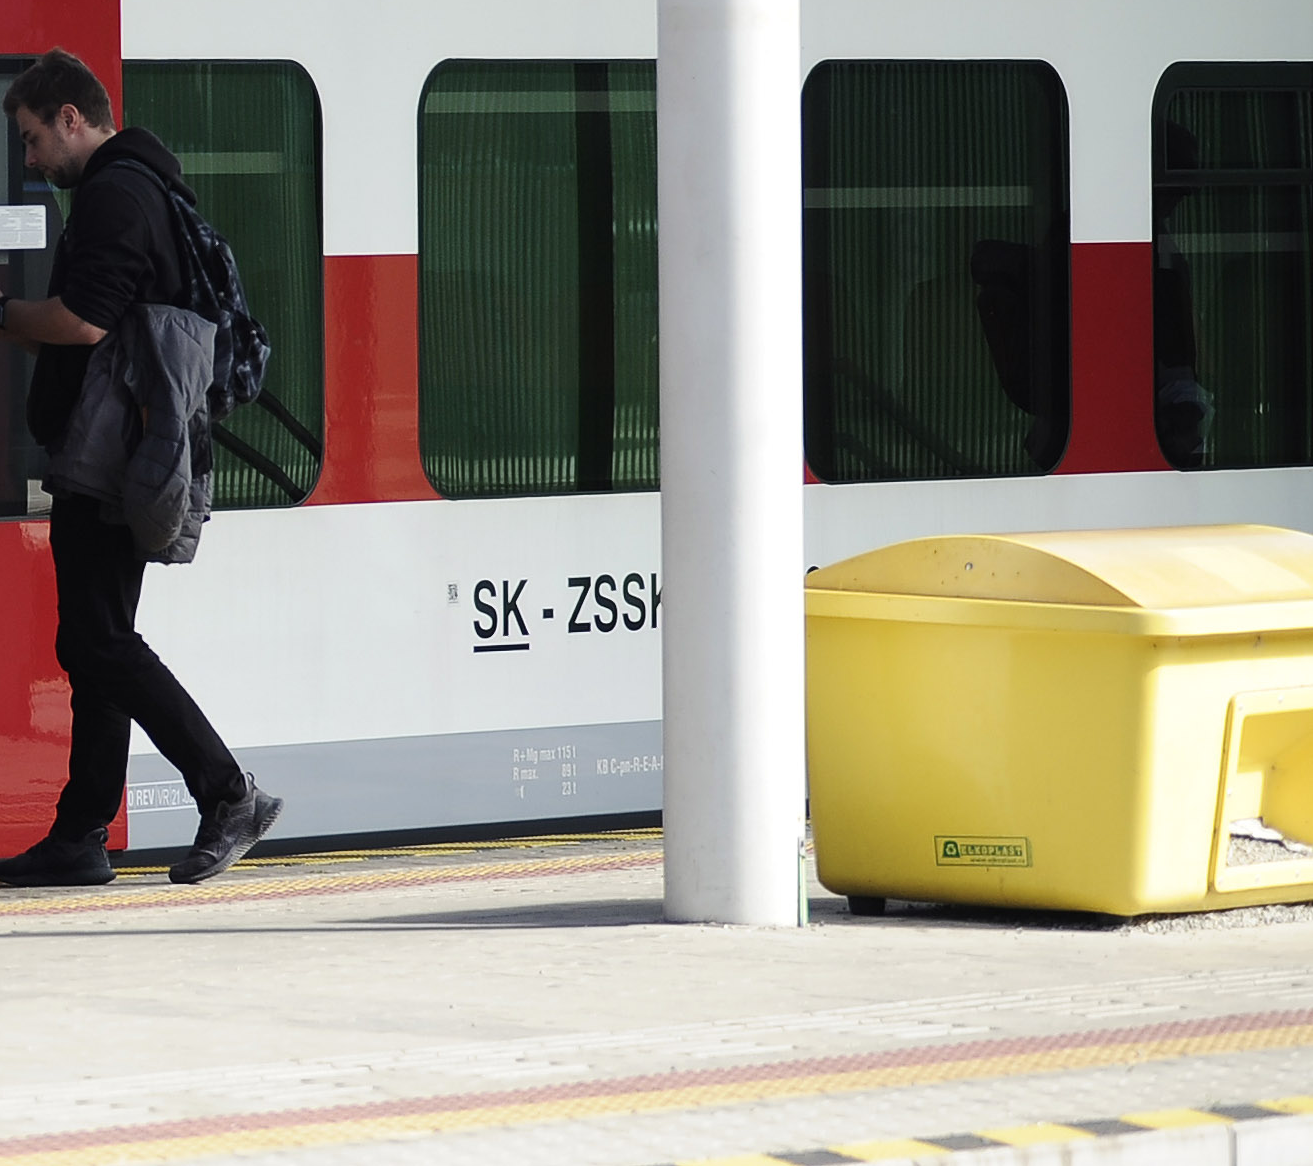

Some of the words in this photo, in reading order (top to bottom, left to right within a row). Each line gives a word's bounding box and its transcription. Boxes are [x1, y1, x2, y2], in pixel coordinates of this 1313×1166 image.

[473, 579, 530, 639] SK
[136, 788, 155, 806] REV
[960, 844, 1023, 857] ELKOPLAST
